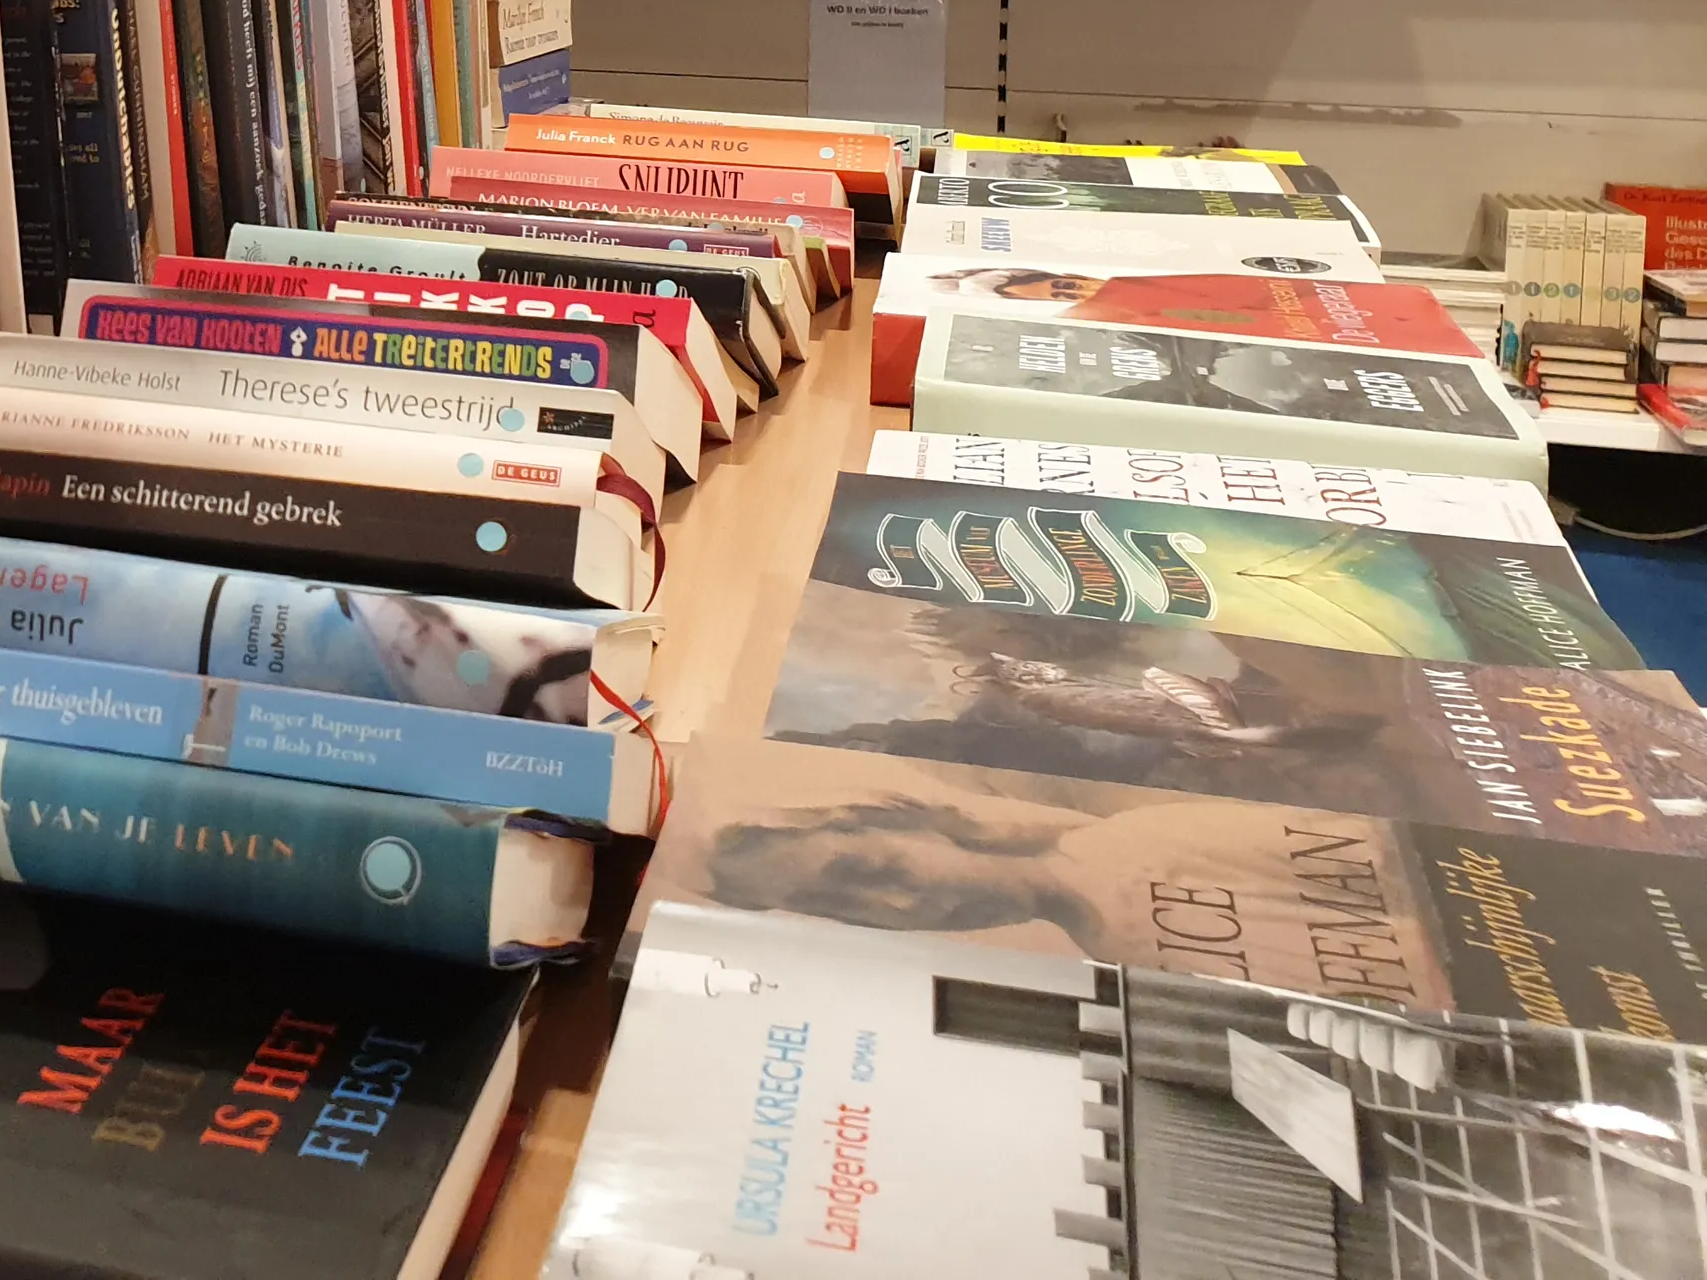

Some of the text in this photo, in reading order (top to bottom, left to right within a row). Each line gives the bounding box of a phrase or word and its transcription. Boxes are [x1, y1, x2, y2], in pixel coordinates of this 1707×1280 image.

[133, 66, 151, 201] CUNNINGHAM
[535, 128, 749, 153] Julia Franck RUG AAN RUG
[478, 192, 555, 208] MARION
[558, 199, 619, 213] BLOEM
[521, 224, 621, 247] Hartedier
[175, 269, 308, 298] ADRIAAN VAN DIS
[1018, 333, 1162, 382] HELDEN GRENS
[13, 359, 515, 432] Hanne-Vibeke Holst Therese's tweestrijd
[1353, 369, 1425, 413] EGGERS
[70, 416, 191, 441] FREDRIKSSON
[208, 431, 245, 447] HET
[251, 435, 344, 459] MYSTERIE
[62, 474, 106, 502] Een
[110, 479, 251, 518] schitterend
[253, 495, 343, 526] gebrek
[497, 465, 556, 481] DE GEUS
[12, 609, 85, 644] Julia
[242, 602, 265, 668] Roman
[268, 603, 291, 674] DuMont
[1496, 556, 1593, 671] HOFFMAN ALICE
[11, 677, 164, 726] thuisgebleven
[249, 704, 403, 744] Roger Rapoport
[244, 733, 377, 767] en Bob Drews
[1422, 667, 1543, 825] SIEBELINK JAN
[1498, 685, 1647, 824] Suezkade
[28, 797, 103, 834] VAN
[115, 814, 154, 845] JE
[172, 822, 295, 862] LEVEN
[17, 985, 166, 1115] MAAR
[849, 1030, 880, 1084] ROMAN
[198, 1010, 337, 1155] IS HET
[298, 1025, 429, 1170] FEEST
[732, 1020, 812, 1239] URSULA KRECHEL
[805, 1101, 881, 1254] Landgericht
